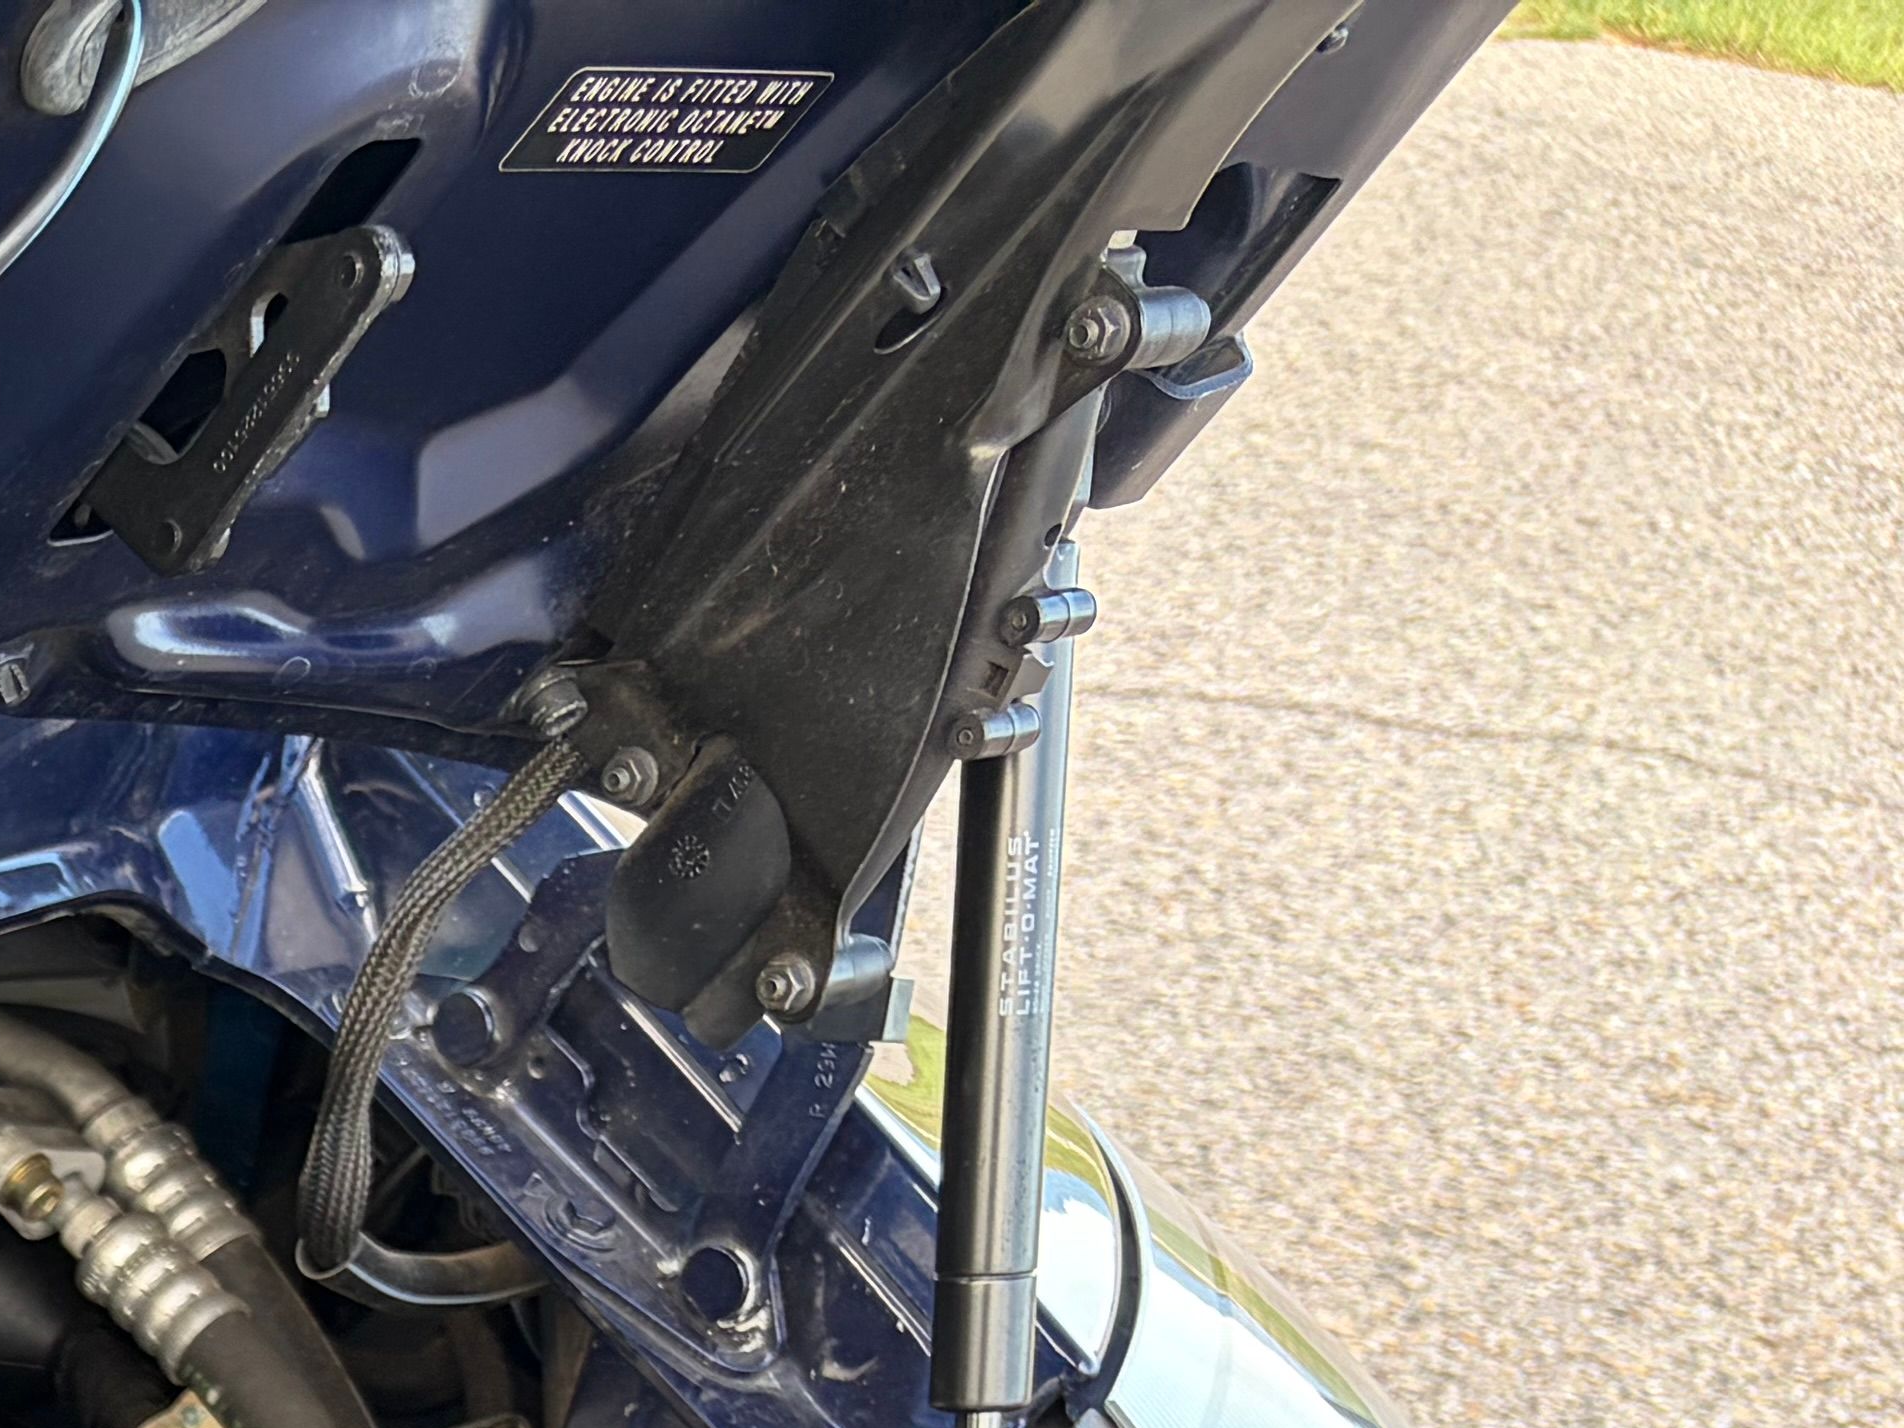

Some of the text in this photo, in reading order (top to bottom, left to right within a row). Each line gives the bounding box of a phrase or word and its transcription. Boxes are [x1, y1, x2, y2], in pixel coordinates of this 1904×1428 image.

[570, 77, 814, 105] ENGINE IS FITTED WITH
[547, 107, 677, 134] ELECTRONIC
[556, 138, 723, 163] KNOCK CONTROL
[999, 837, 1023, 1017] STABILUS
